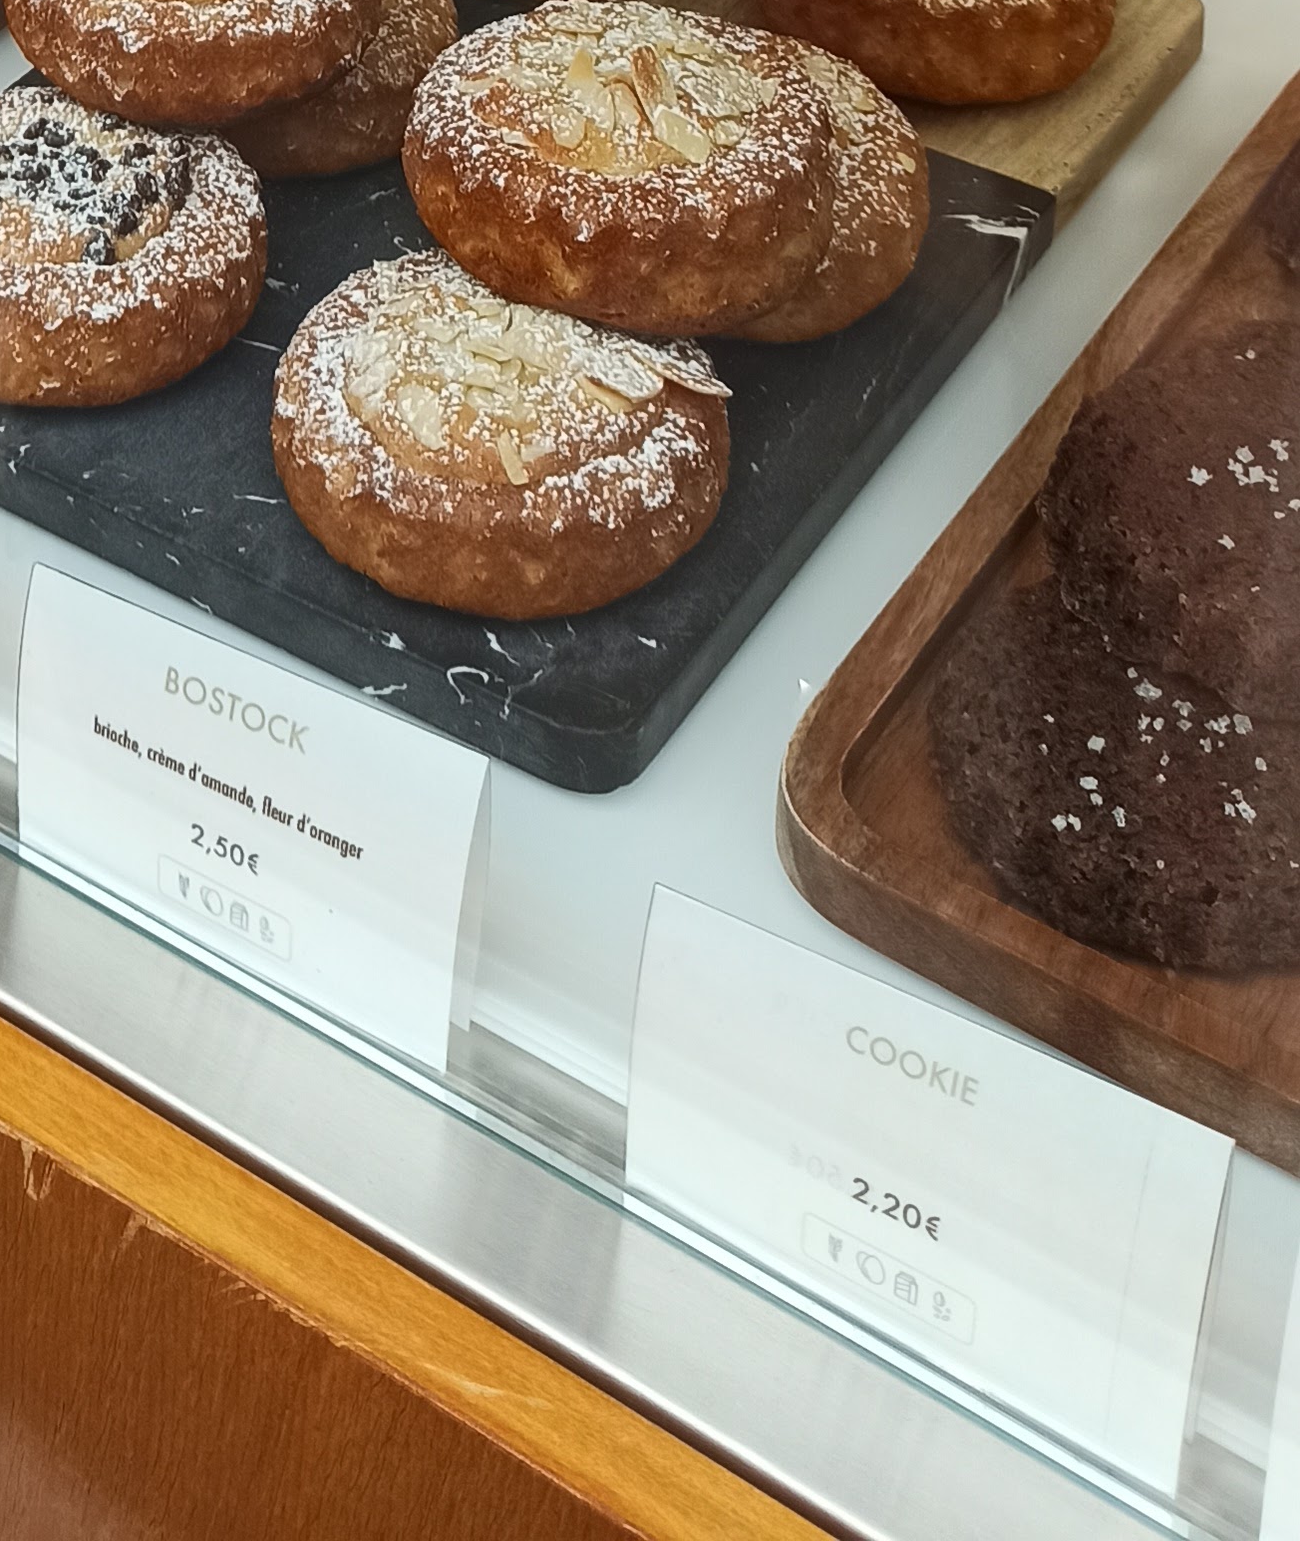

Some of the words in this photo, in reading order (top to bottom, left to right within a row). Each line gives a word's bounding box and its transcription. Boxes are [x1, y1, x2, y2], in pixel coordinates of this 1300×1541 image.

[163, 665, 311, 755] BOSTOCK
[93, 714, 143, 758] brioche,
[146, 745, 186, 777] crème
[261, 795, 294, 828] fleur
[296, 813, 365, 861] d'oranger
[190, 822, 261, 876] 2,50€
[845, 1024, 981, 1108] COOKIE
[850, 1176, 943, 1242] 2,20€
